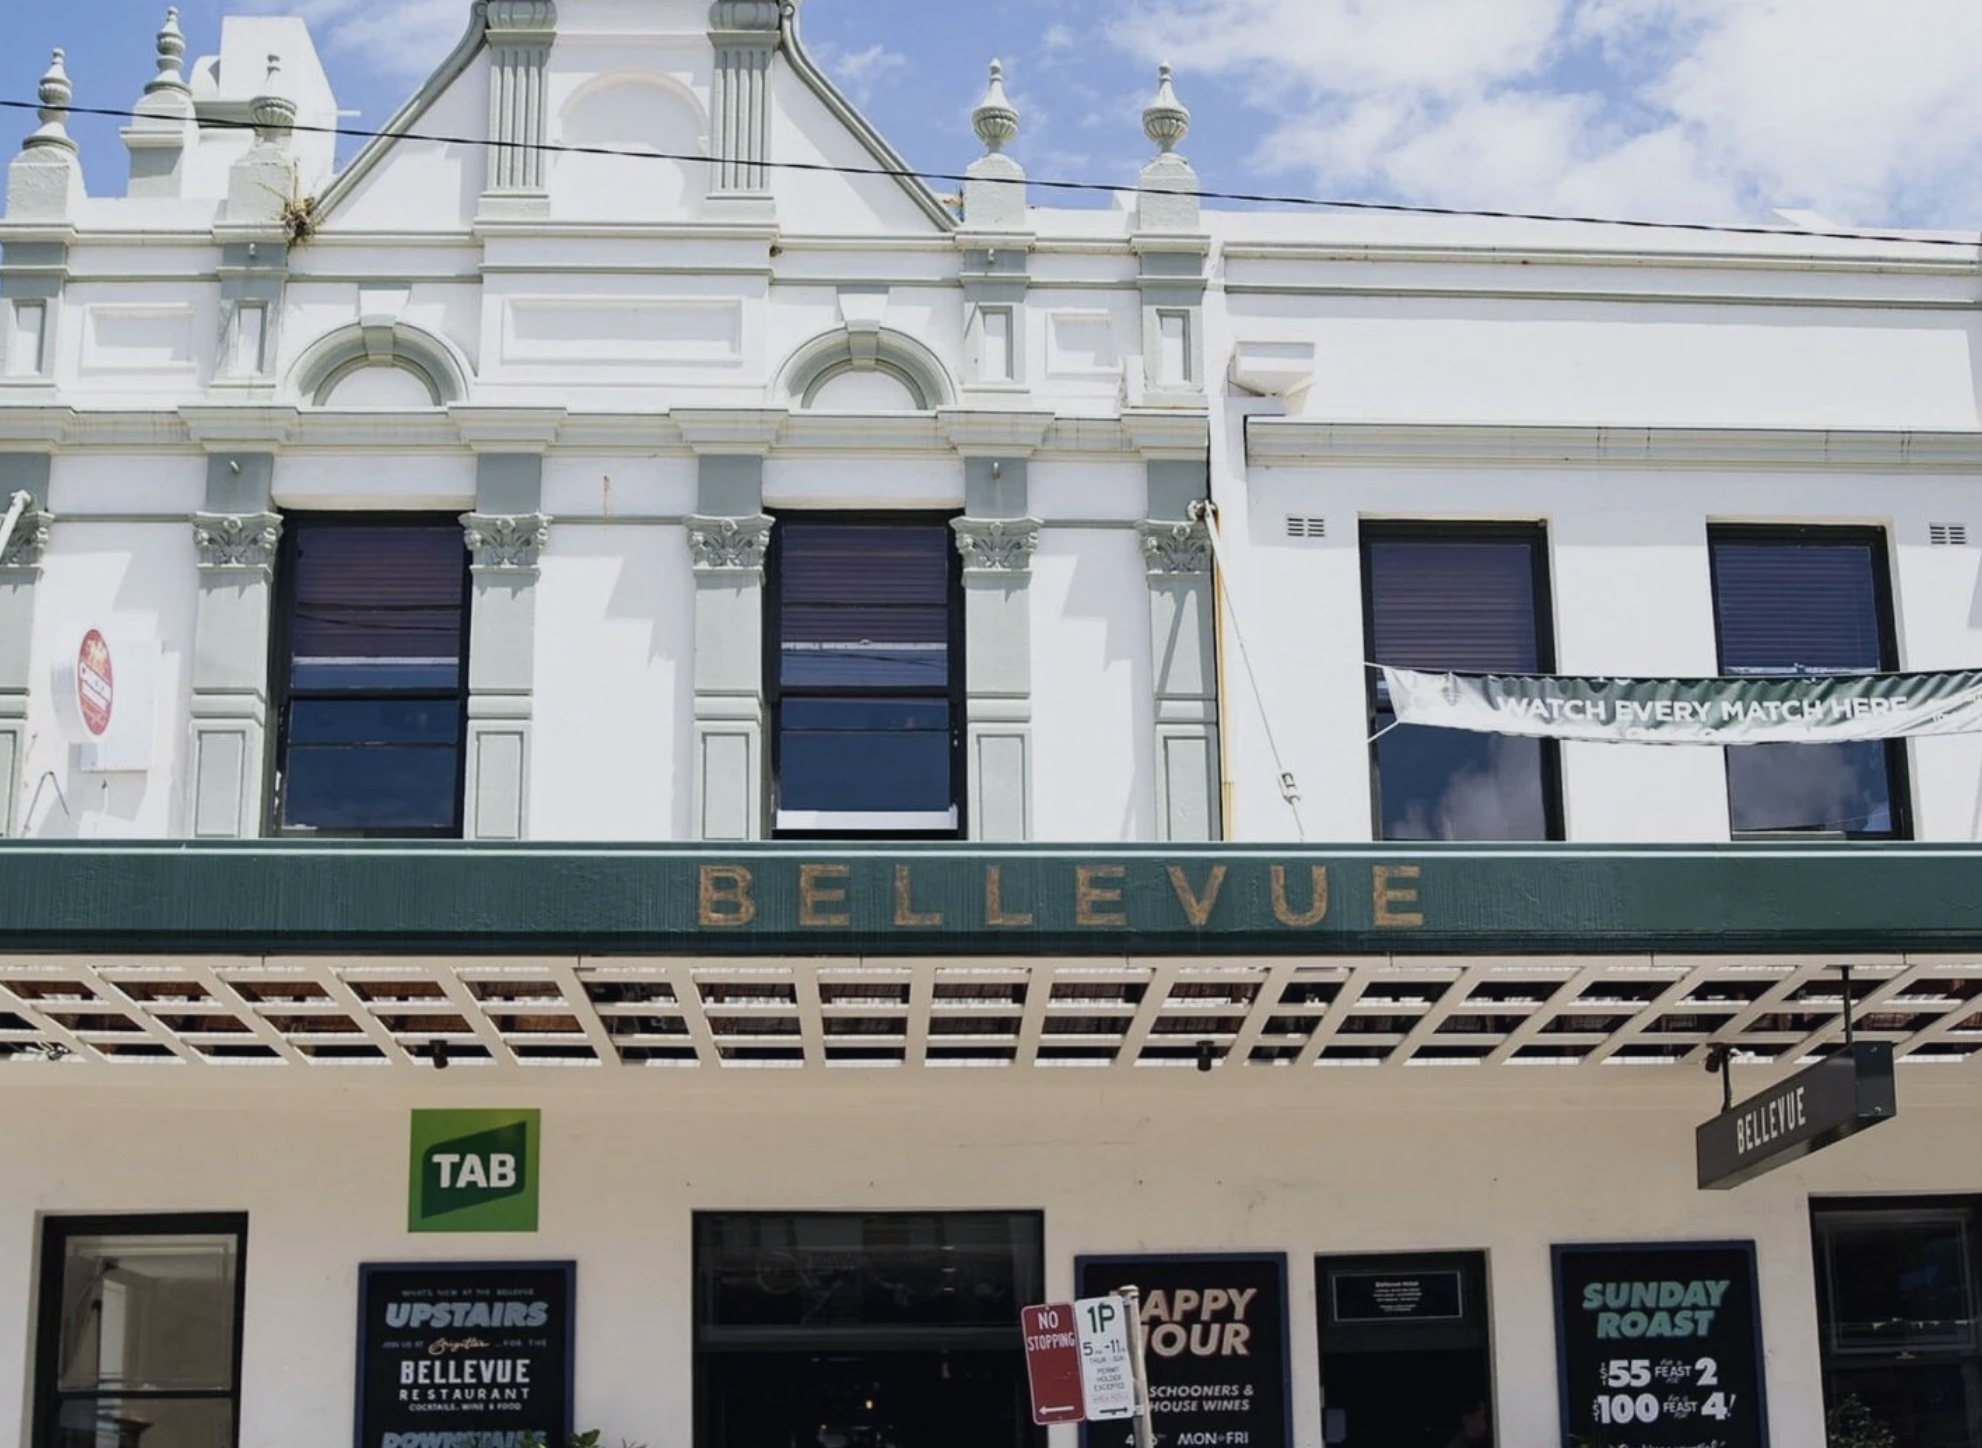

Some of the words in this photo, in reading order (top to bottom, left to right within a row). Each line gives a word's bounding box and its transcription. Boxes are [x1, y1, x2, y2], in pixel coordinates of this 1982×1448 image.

[1497, 697, 1605, 721] WATCH
[1615, 700, 1711, 722] EVERY
[1721, 699, 1822, 722] MATCH
[1831, 696, 1908, 720] HERE
[698, 864, 1424, 927] BELLEVUE
[1736, 1086, 1806, 1155] BELLEVUE
[432, 1153, 516, 1188] TAB
[1141, 1287, 1257, 1323] APPY
[1582, 1280, 1731, 1310] SUNDAY
[385, 1301, 549, 1328] UPSTAIRS
[1037, 1310, 1060, 1331] NO
[1087, 1302, 1115, 1334] 1P
[1596, 1310, 1715, 1339] ROAST
[1027, 1332, 1076, 1352] STOPPING
[1143, 1322, 1250, 1357] OUR
[400, 1359, 531, 1385] BELLEVUE
[1654, 1366, 1692, 1378] FEAST
[1695, 1356, 1719, 1386] 2
[399, 1387, 530, 1401] RESTAURANT
[1149, 1384, 1240, 1398] SCHOONERS
[1242, 1383, 1254, 1397] &
[462, 1402, 484, 1411] WINE
[497, 1402, 522, 1411] FOOD
[1202, 1398, 1250, 1412] WINES
[1662, 1401, 1699, 1413] FEAST
